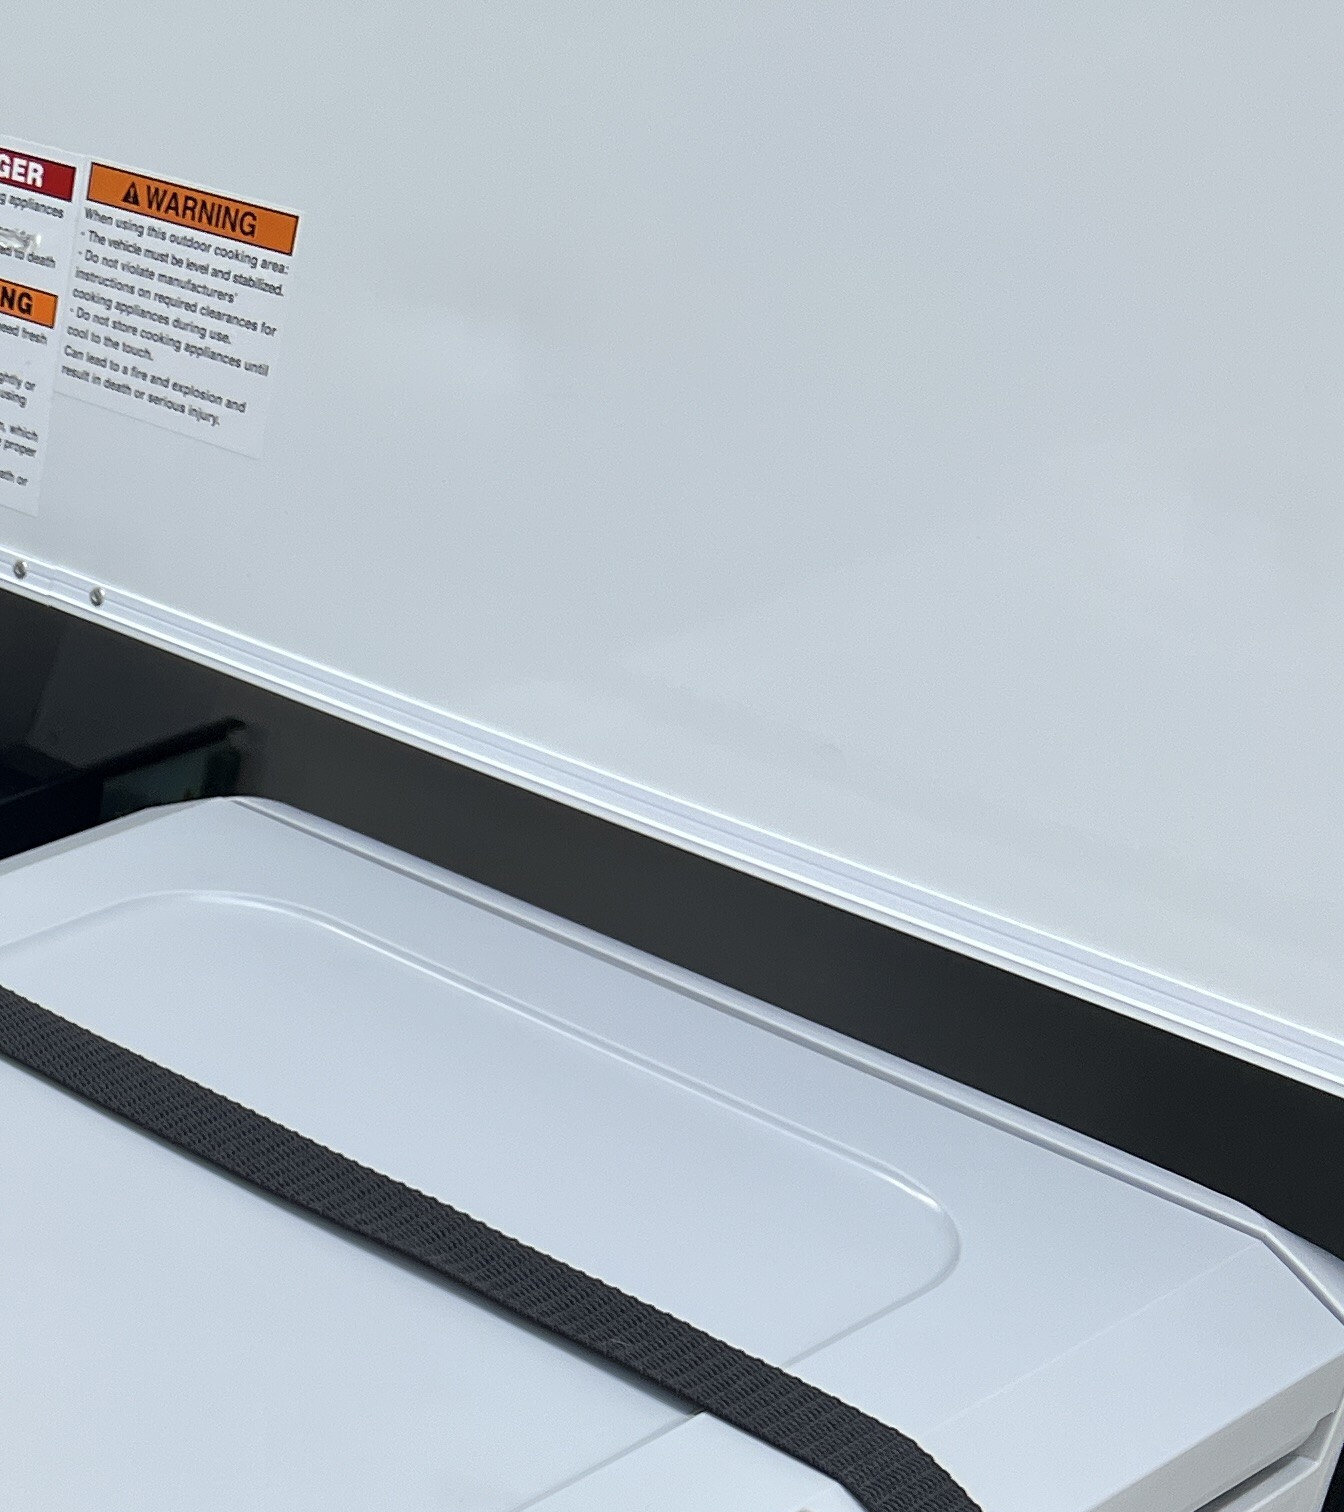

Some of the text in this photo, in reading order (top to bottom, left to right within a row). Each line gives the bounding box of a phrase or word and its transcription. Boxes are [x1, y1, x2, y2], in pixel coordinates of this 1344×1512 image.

[84, 206, 113, 225] When
[115, 218, 144, 237] using
[146, 225, 166, 241] this
[168, 233, 212, 253] outdoor
[213, 246, 258, 269] cooking
[146, 185, 258, 238] WARNING
[84, 248, 99, 263] Do
[100, 256, 118, 270] not
[120, 261, 155, 280] violate
[88, 229, 106, 245] The
[107, 238, 142, 256] vehicle
[143, 248, 169, 264] must
[170, 253, 184, 268] be
[185, 257, 209, 275] level
[210, 267, 231, 281] and
[72, 287, 113, 311] cooking
[113, 300, 169, 325] appliances
[171, 317, 207, 339] during
[74, 266, 277, 336] instructions on required clearances for
[66, 325, 89, 340] cool
[89, 331, 101, 344] to
[102, 335, 120, 350] the
[75, 306, 269, 376] Do not store cooking appliances until
[61, 365, 90, 382] result
[91, 373, 101, 385] in
[102, 377, 132, 396] death
[133, 389, 145, 400] or
[146, 393, 185, 414] serious
[64, 344, 246, 413] Can lead to a fire and explosion and
